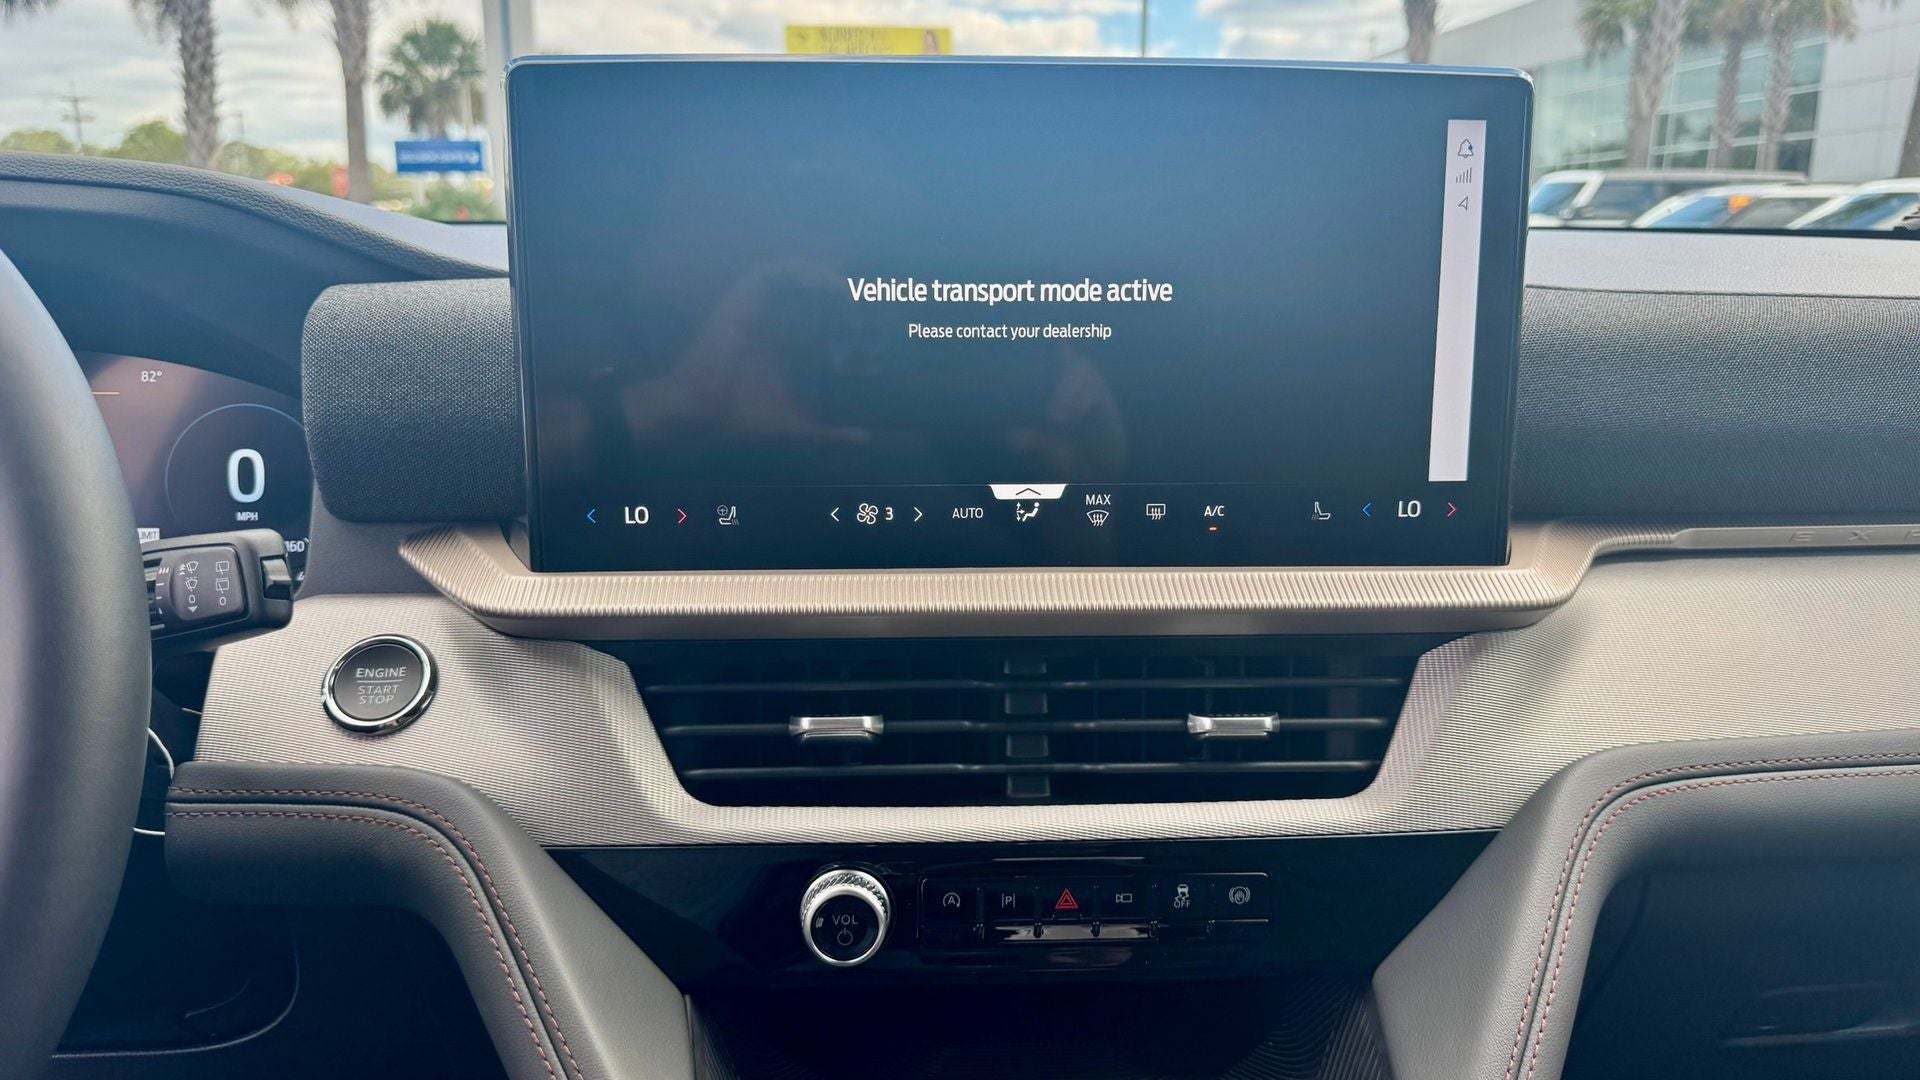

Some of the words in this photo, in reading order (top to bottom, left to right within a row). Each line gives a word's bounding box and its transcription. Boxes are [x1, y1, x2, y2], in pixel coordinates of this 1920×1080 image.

[847, 277, 928, 302] Vehicle
[931, 279, 1036, 306] transport
[1040, 277, 1102, 302] mode
[1106, 278, 1173, 302] active
[908, 323, 953, 338] Please
[956, 324, 1008, 338] contact
[1010, 326, 1041, 341] your
[1042, 323, 1112, 341] dealership
[140, 370, 163, 382] 82°
[227, 448, 266, 503] 0
[1085, 494, 1111, 505] MAX
[885, 507, 894, 521] 3
[952, 507, 984, 520] AUTO
[1204, 505, 1225, 517] A/C
[1398, 500, 1421, 518] LO
[236, 511, 259, 521] MPH
[624, 506, 649, 525] LO
[355, 666, 407, 678] ENGINE
[358, 684, 400, 695] START
[359, 695, 395, 705] STOP
[1173, 900, 1191, 909] OFF
[831, 914, 859, 926] VOL
